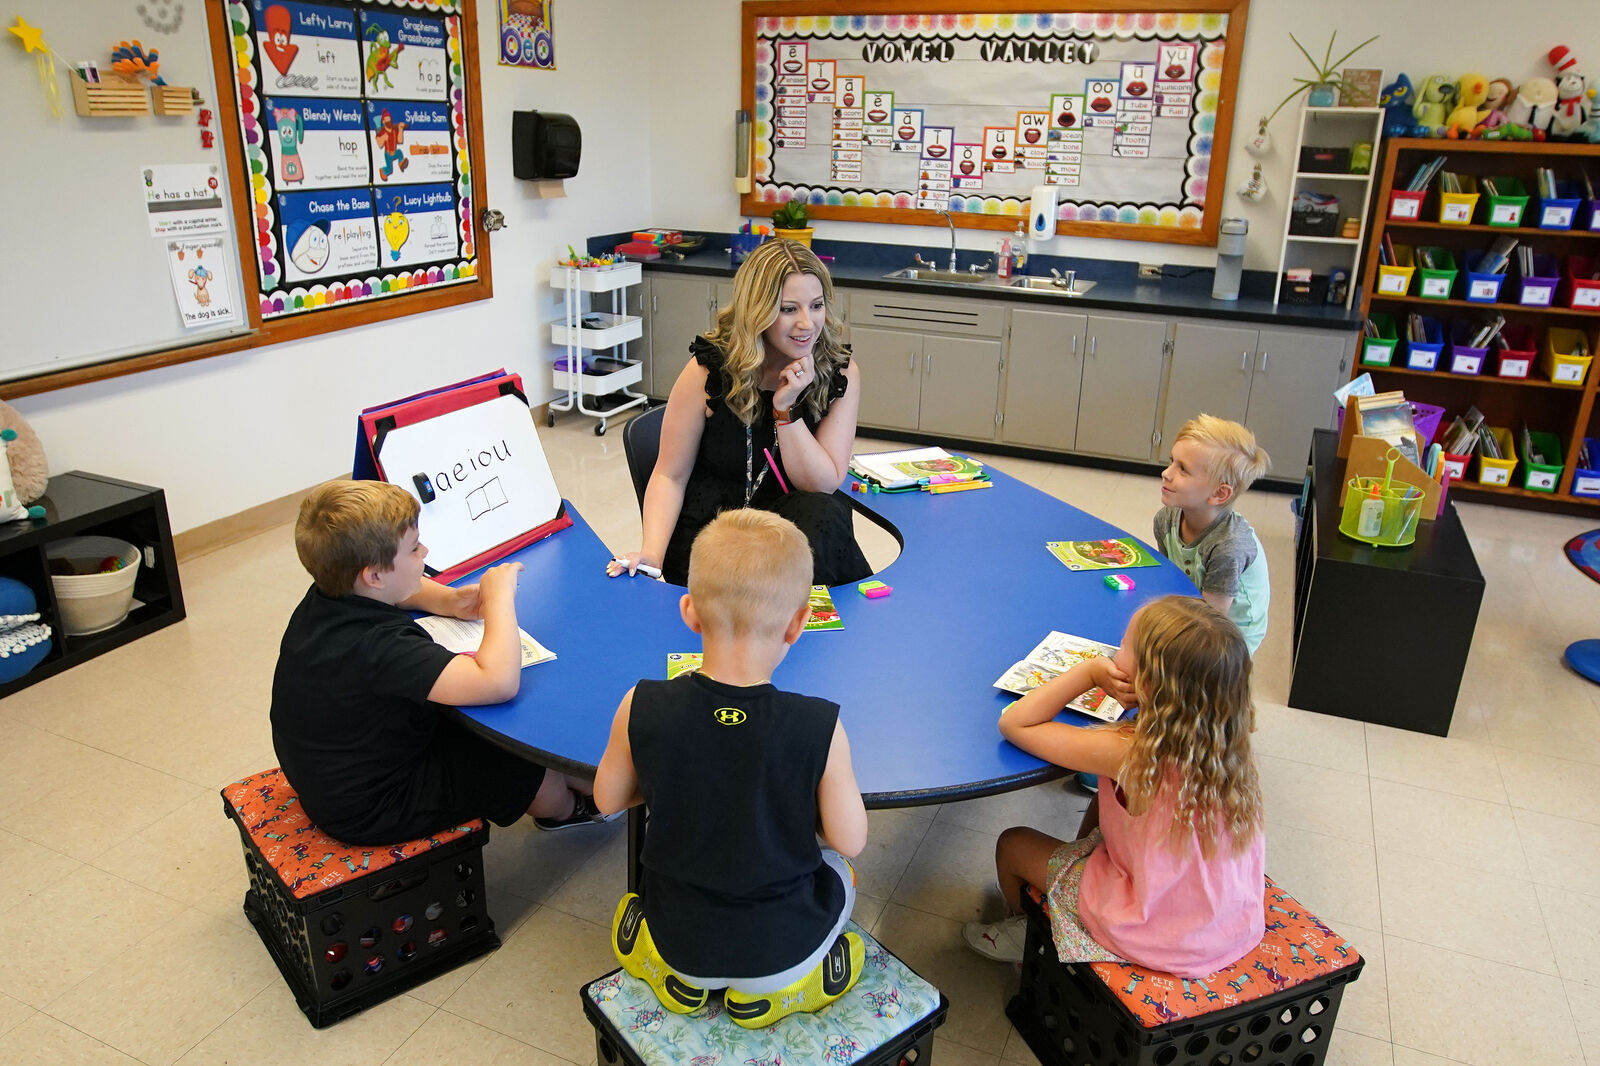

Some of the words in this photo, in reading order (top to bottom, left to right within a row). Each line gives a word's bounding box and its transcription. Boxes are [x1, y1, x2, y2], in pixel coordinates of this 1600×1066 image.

[299, 12, 326, 30] Lefty
[328, 15, 353, 32] Larry
[403, 18, 439, 35] Grapheme
[398, 30, 442, 46] Grasshopper
[317, 50, 335, 64] left
[866, 42, 950, 62] VOWEL
[986, 41, 1094, 63] VALLEY
[1093, 82, 1113, 93] oo
[303, 108, 331, 123] Blendy
[333, 109, 361, 124] Wendy
[405, 110, 430, 124] Syllable
[432, 111, 447, 122] Sam
[1023, 115, 1045, 126] aw
[339, 136, 358, 153] hop
[148, 190, 160, 199] He
[164, 188, 180, 198] has
[404, 195, 421, 206] Lucy
[422, 191, 452, 206] Lightbulb
[309, 201, 334, 213] Chase
[336, 199, 350, 211] the
[351, 198, 370, 210] Base
[320, 871, 341, 887] PETE
[1260, 942, 1282, 953] PETE
[1151, 976, 1174, 987] PETE
